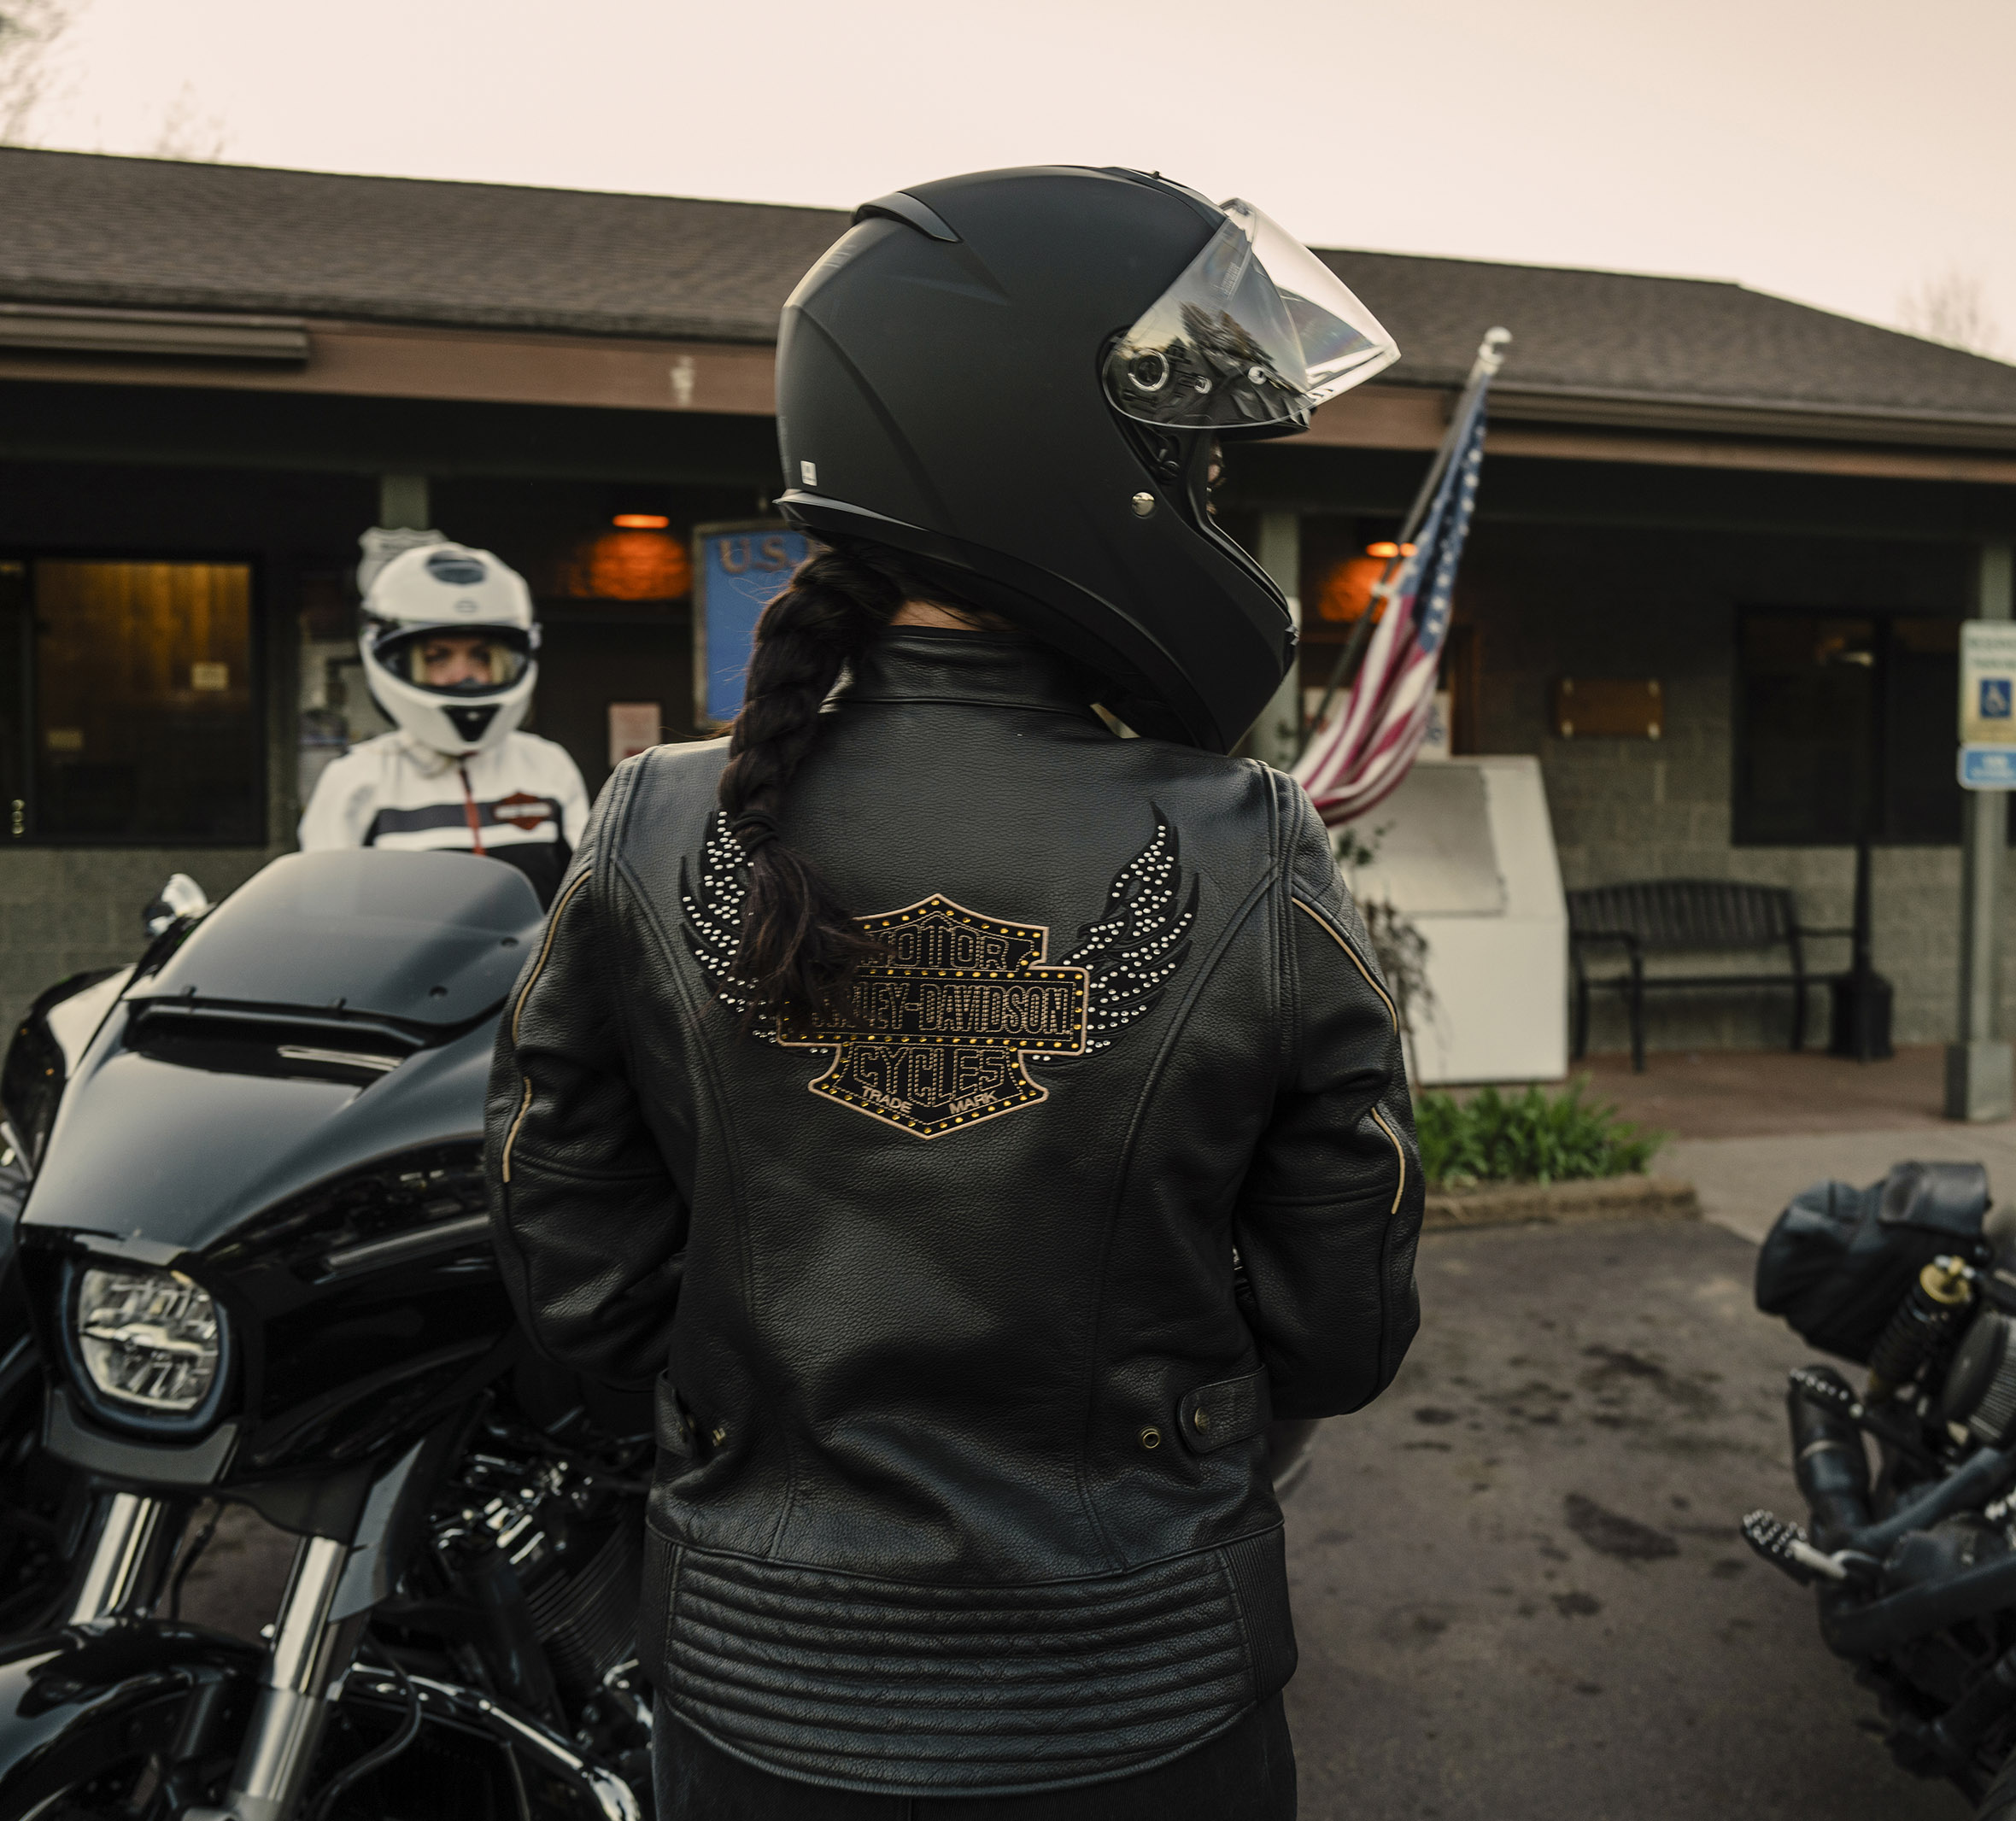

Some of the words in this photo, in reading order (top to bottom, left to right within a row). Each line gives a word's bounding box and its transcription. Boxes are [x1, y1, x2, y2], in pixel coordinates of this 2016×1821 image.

[854, 1045, 1005, 1108] CYCLES
[862, 1086, 914, 1114] TRADE
[948, 1090, 999, 1115] MARK
